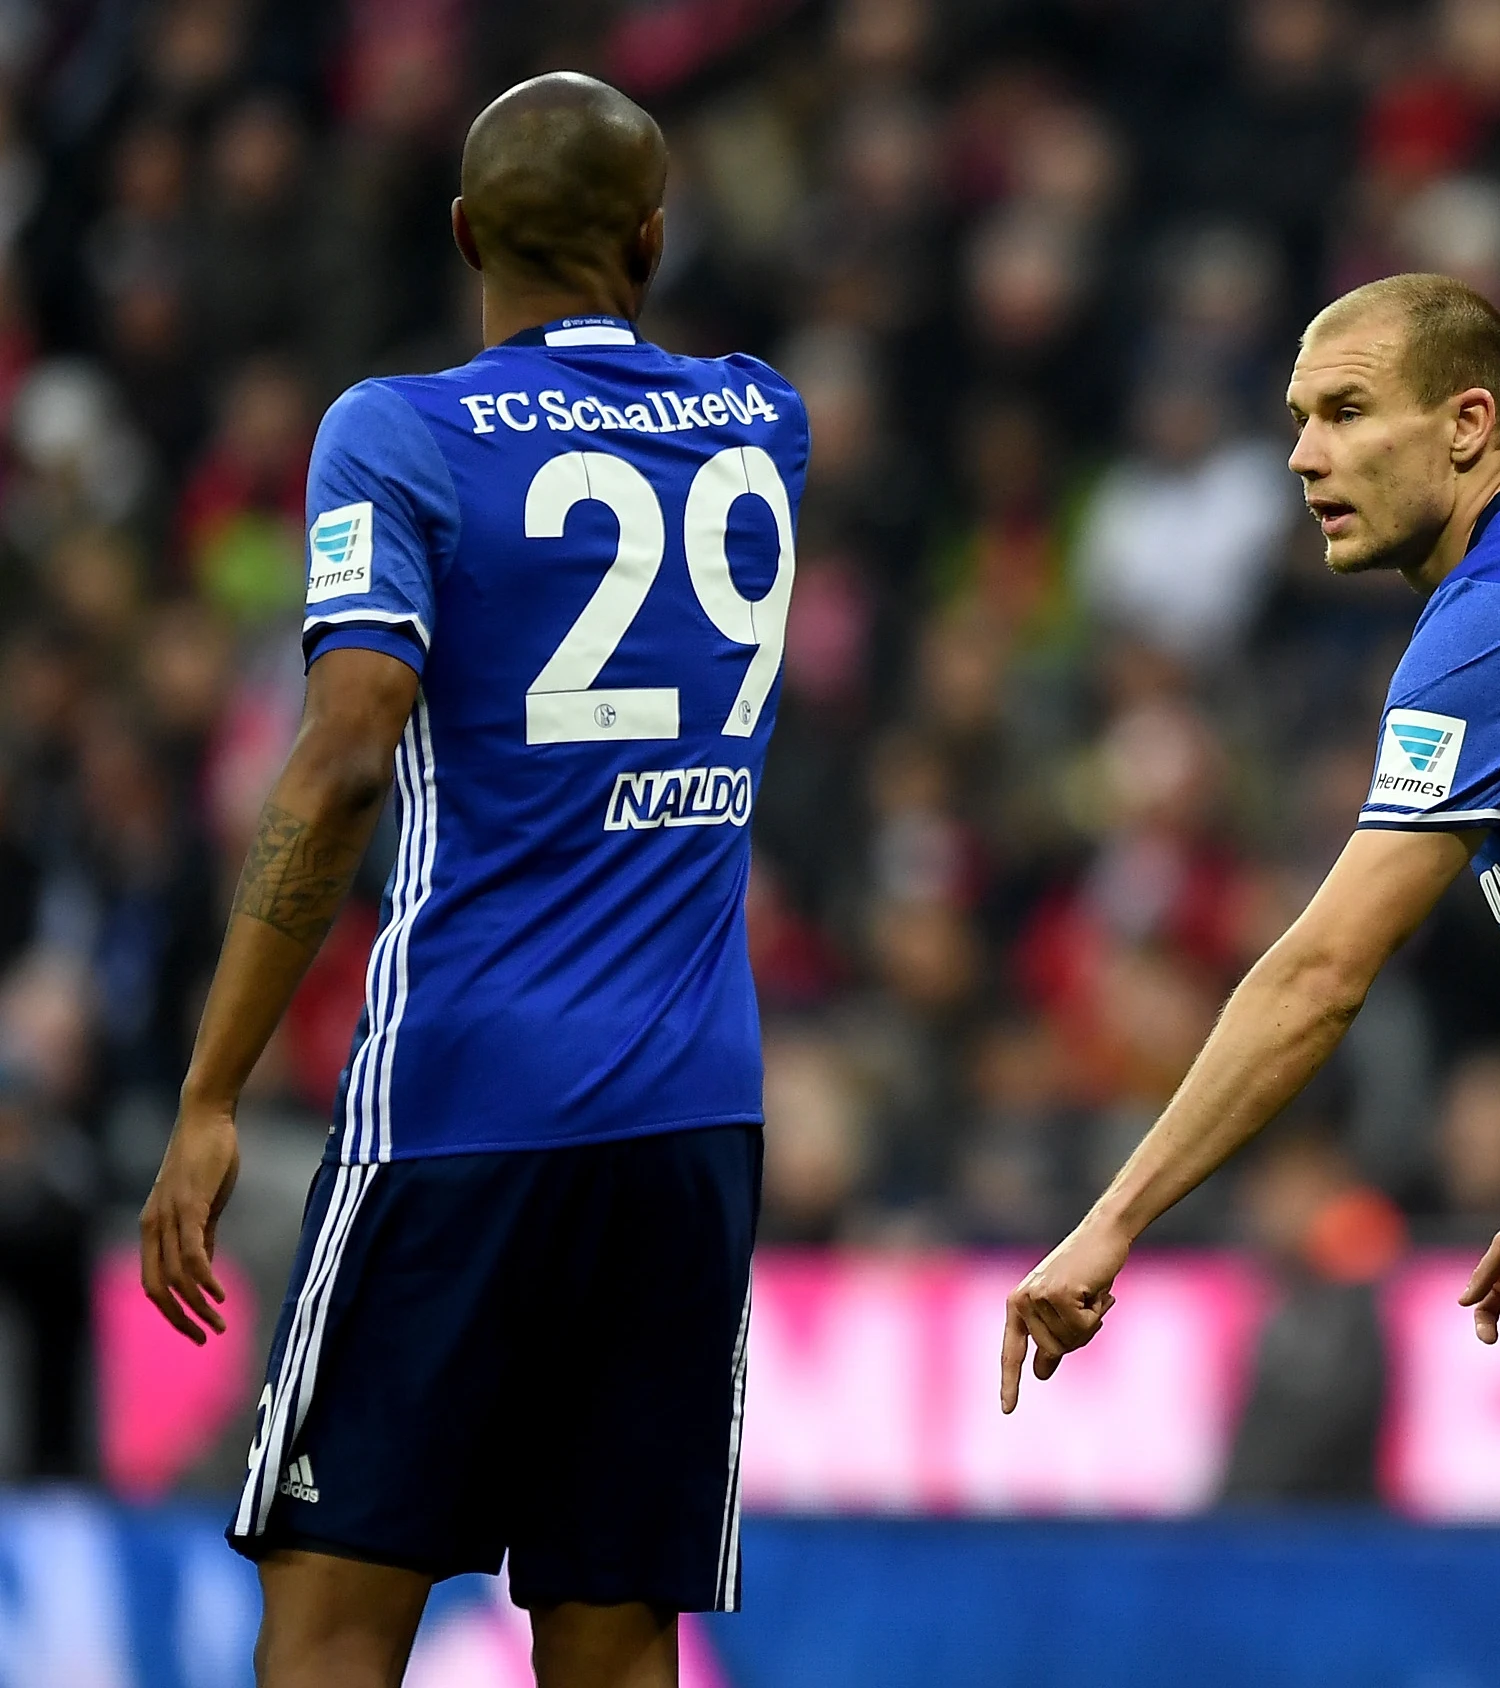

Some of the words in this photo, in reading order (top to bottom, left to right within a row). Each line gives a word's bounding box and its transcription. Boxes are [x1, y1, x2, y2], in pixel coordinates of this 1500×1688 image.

[460, 392, 537, 434] FC
[524, 445, 796, 746] 29
[603, 767, 752, 831] NALDO
[1375, 773, 1447, 799] Hermes
